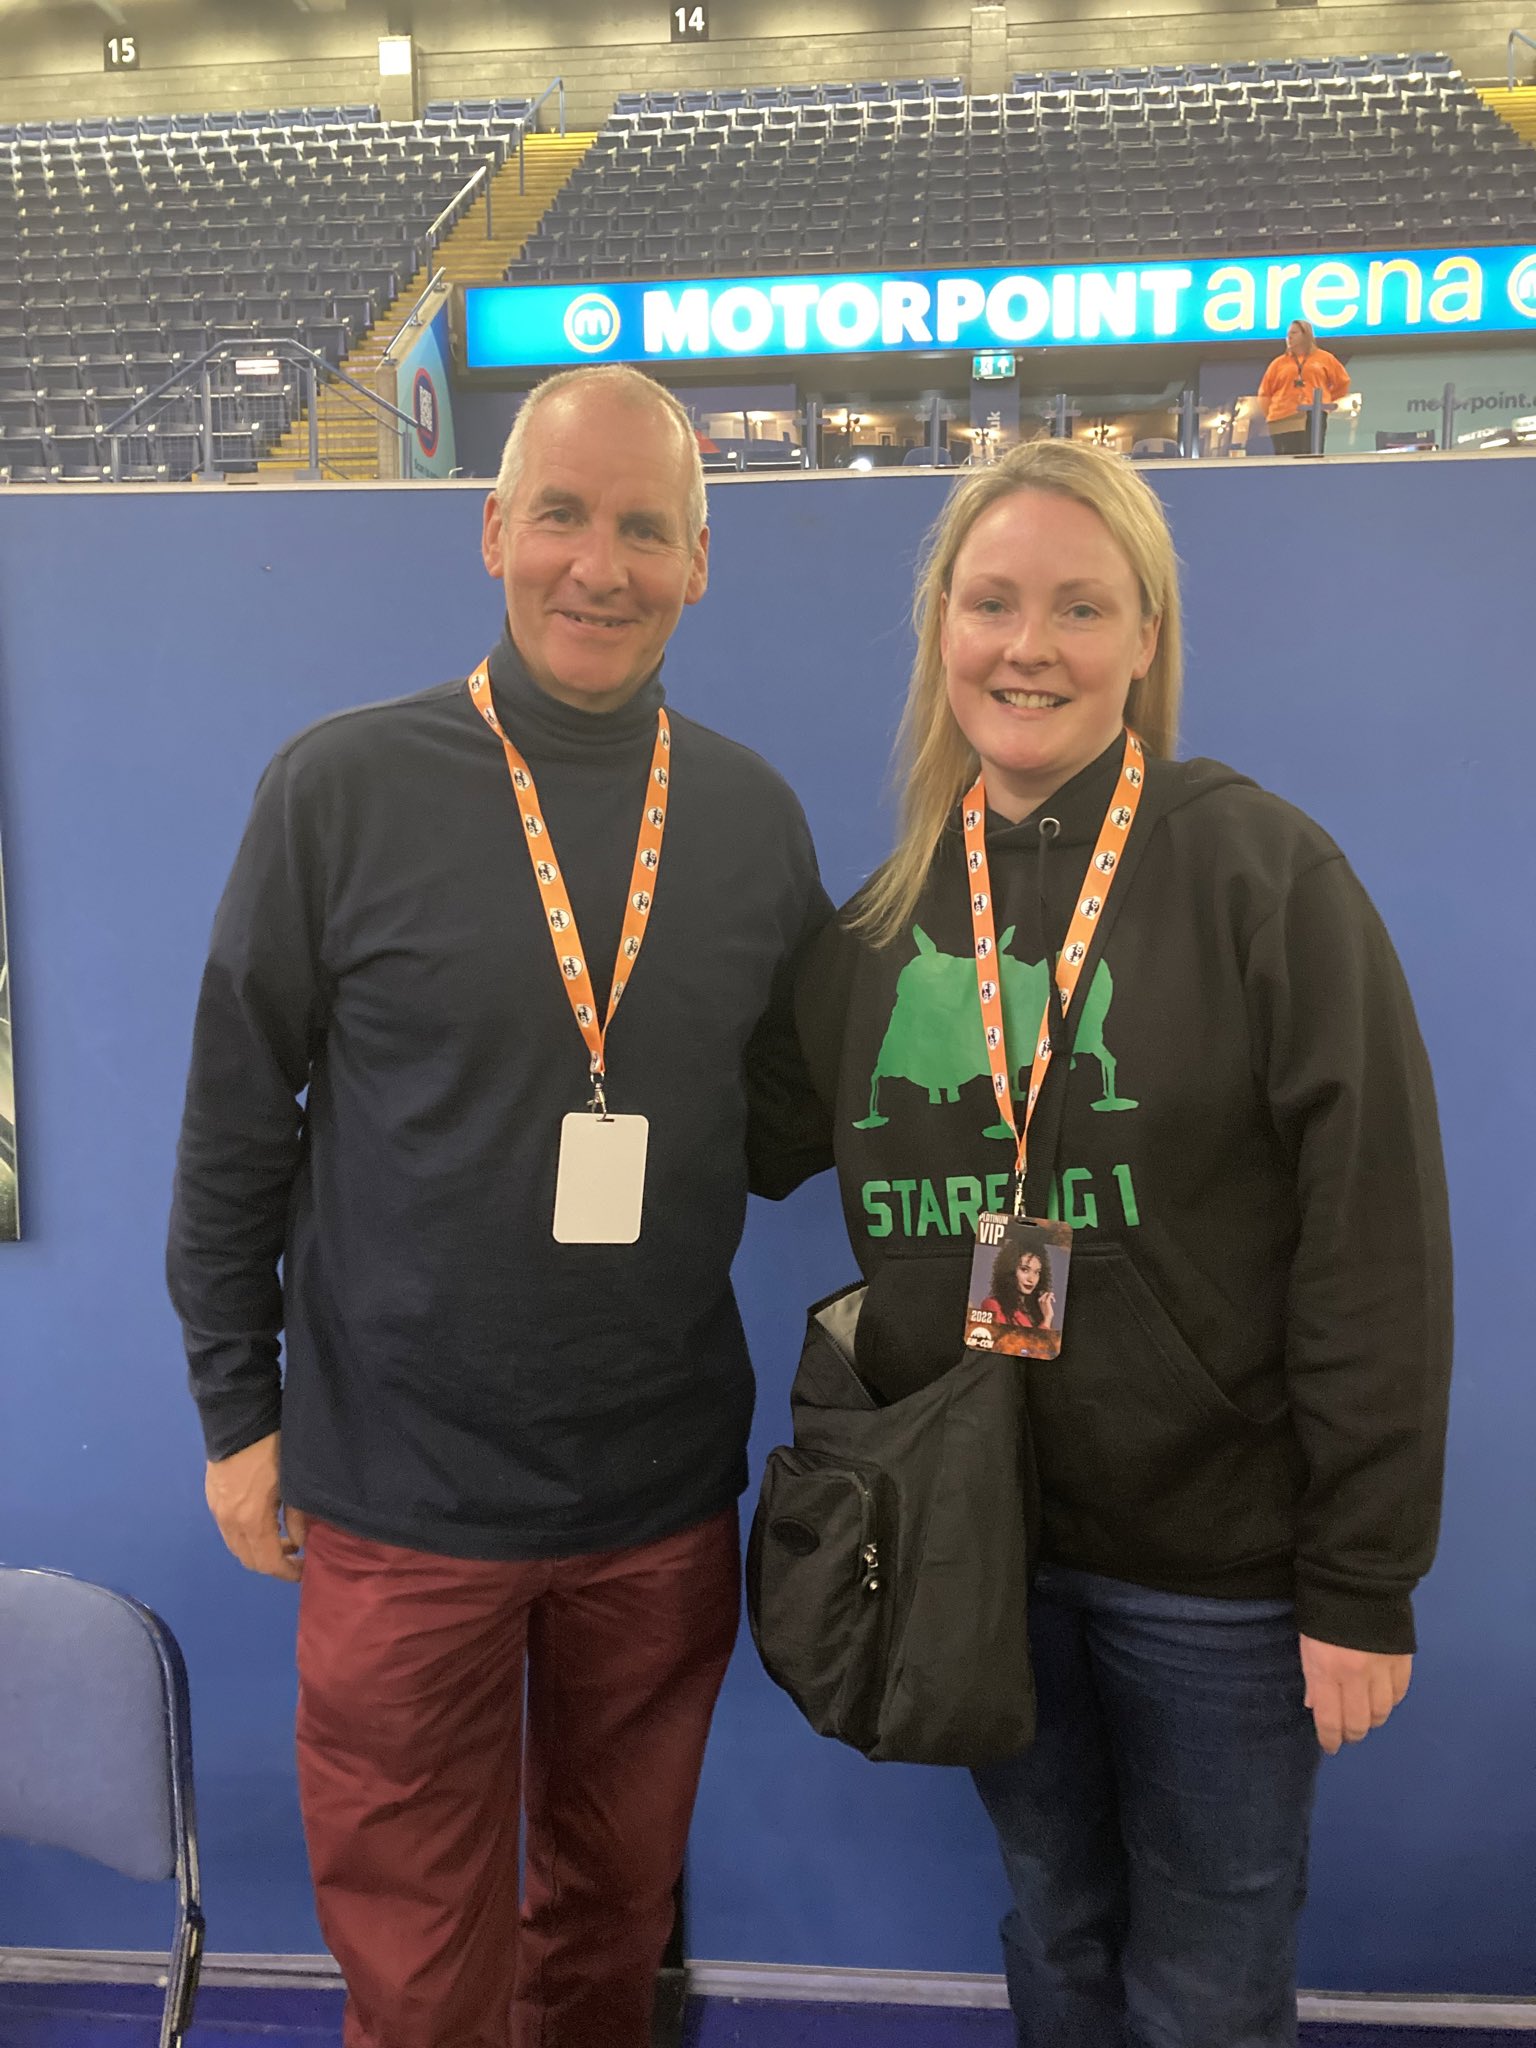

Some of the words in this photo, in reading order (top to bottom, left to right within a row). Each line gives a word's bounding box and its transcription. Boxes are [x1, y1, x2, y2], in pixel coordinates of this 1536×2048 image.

[674, 6, 706, 33] 14
[107, 37, 136, 63] 15
[643, 269, 1192, 353] MOTORPOINT
[1203, 255, 1484, 333] arena
[862, 1166, 1098, 1238] STARG
[1111, 1163, 1141, 1227] 1
[979, 1221, 1005, 1246] VIP
[970, 1309, 993, 1325] 2022
